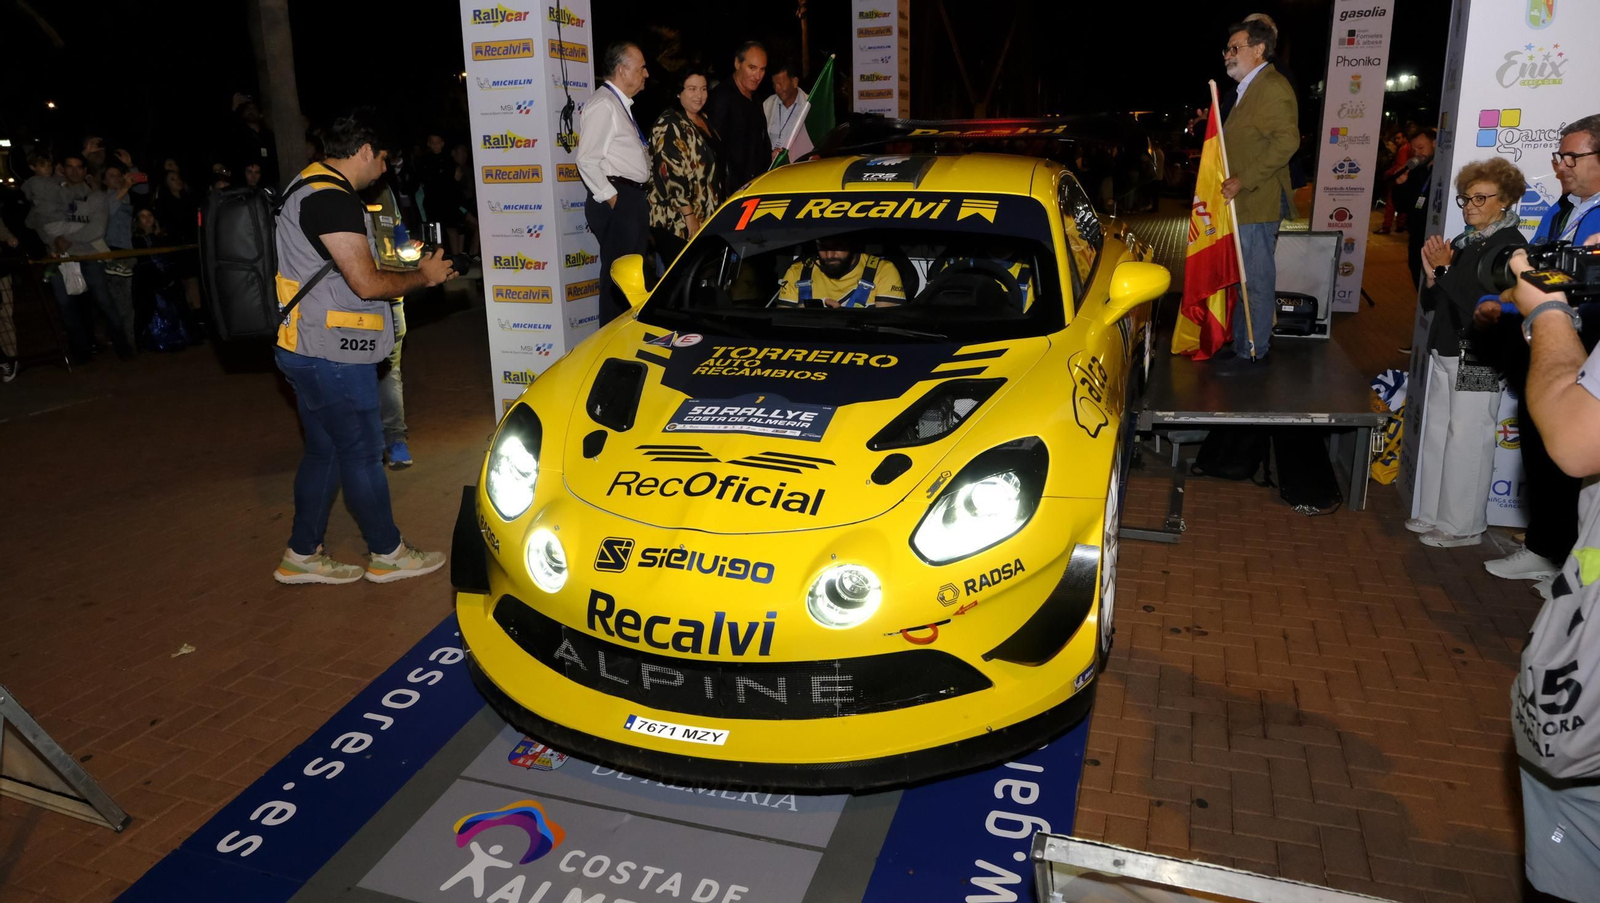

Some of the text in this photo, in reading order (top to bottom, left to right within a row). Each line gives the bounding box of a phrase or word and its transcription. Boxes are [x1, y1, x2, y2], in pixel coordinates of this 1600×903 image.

[473, 7, 529, 23] Rallycar
[1339, 6, 1387, 21] gasolia
[484, 43, 521, 56] Recalvi
[1336, 55, 1381, 67] Phonika
[1495, 50, 1569, 89] Enix
[491, 79, 532, 87] MICHELIN
[483, 134, 538, 149] Rallycar
[1496, 122, 1566, 162] garcí
[494, 168, 531, 180] Recalvi
[734, 197, 952, 231] 1 Recalvi
[493, 256, 548, 271] Rallycar
[565, 253, 599, 269] Rallycar
[504, 288, 541, 300] Recalvi
[340, 337, 376, 351] 2025
[699, 358, 762, 368] AUTO
[710, 346, 900, 369] TORREIRO
[692, 366, 829, 381] RECAMBIOS
[755, 395, 766, 404] 1
[688, 406, 819, 422] 50 RALLYE
[683, 415, 726, 423] COSTA
[748, 417, 812, 429] ALMERÍA
[606, 471, 826, 516] RecOficial
[963, 557, 1026, 597] RADSA
[587, 588, 778, 656] Recalvi
[553, 637, 855, 705] ALPINE
[637, 719, 724, 743] 7671 MZY
[559, 850, 683, 898] COSTA
